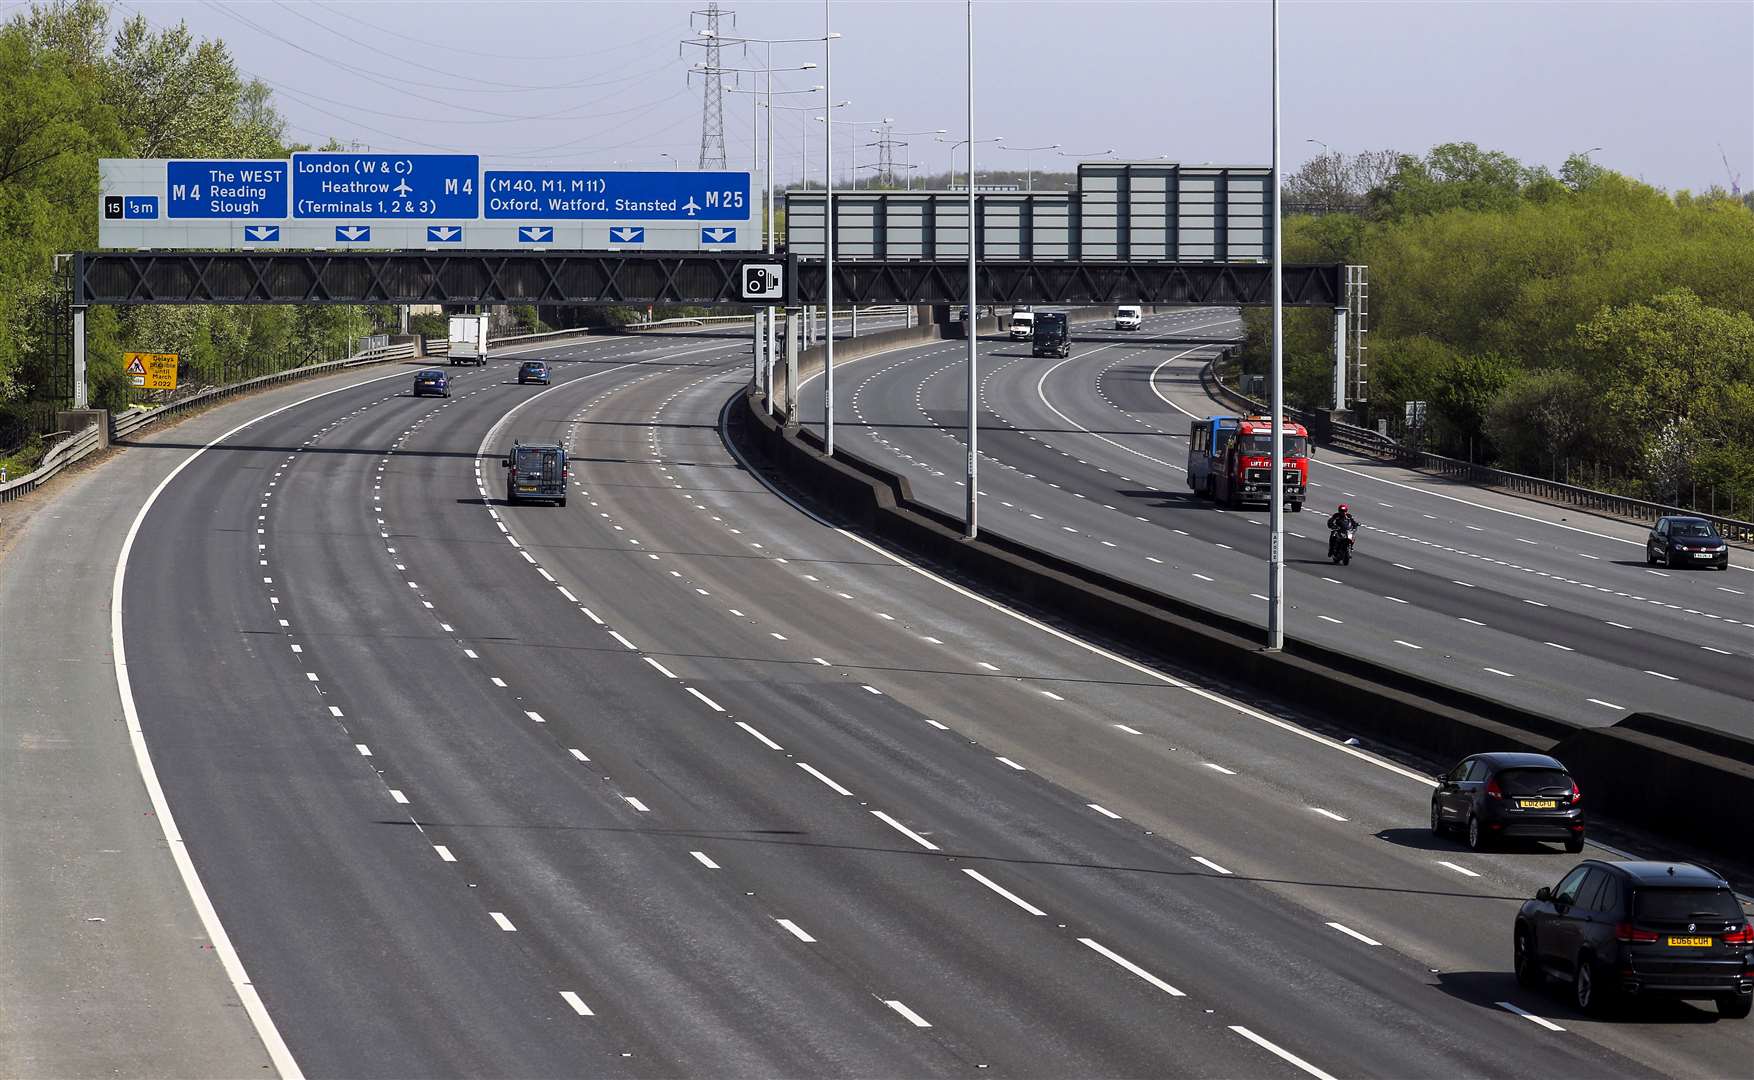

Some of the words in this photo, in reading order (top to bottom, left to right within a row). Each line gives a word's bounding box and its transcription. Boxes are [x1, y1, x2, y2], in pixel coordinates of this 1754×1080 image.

[299, 162, 350, 174] London
[354, 160, 380, 175] (W
[380, 162, 390, 173] &
[394, 160, 414, 175] C)
[209, 170, 234, 182] The
[240, 170, 282, 182] WEST
[210, 186, 266, 200] Reading
[322, 180, 390, 193] Heathrow
[298, 199, 373, 214] (Terminals
[378, 201, 388, 214] 1,
[392, 201, 400, 214] 2
[405, 202, 415, 214] &
[419, 199, 437, 215] 3)
[490, 198, 542, 212] Oxford,
[549, 199, 610, 213] Watford,
[615, 199, 677, 213] Stansted
[706, 191, 744, 208] M25
[107, 203, 120, 214] 15
[210, 200, 260, 215] Slough
